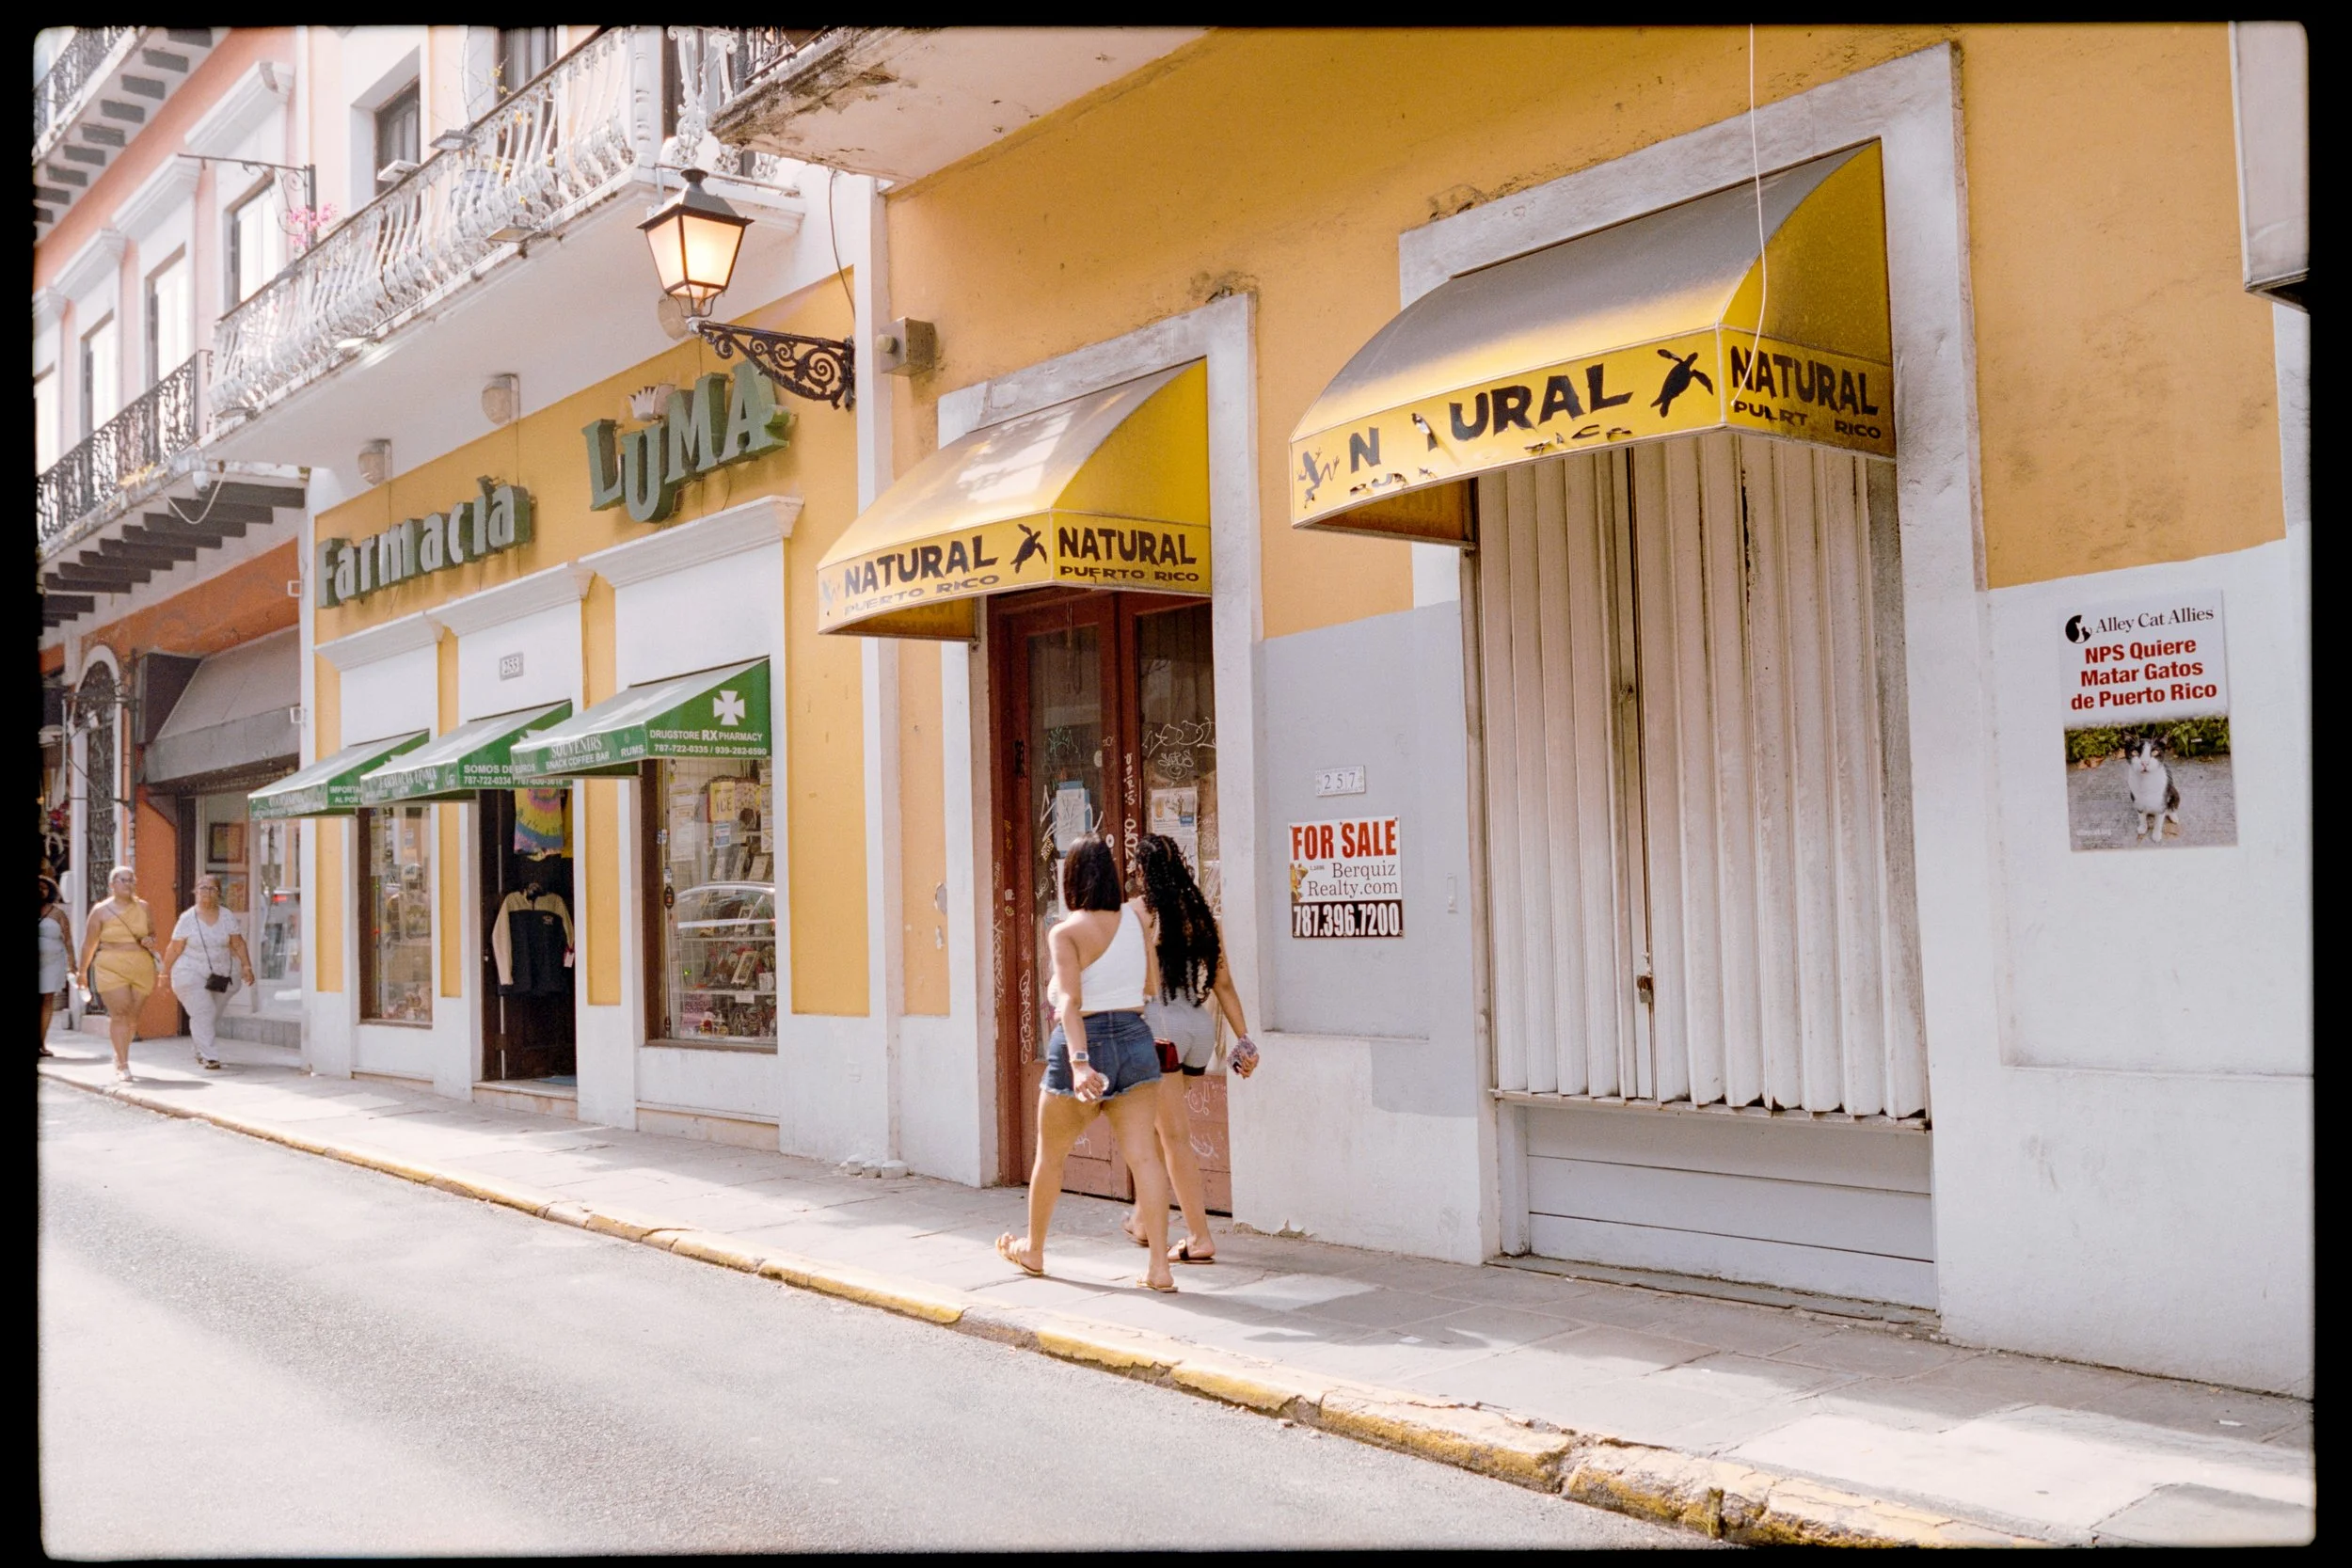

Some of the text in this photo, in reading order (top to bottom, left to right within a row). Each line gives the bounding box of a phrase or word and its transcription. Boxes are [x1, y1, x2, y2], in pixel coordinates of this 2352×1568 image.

[1730, 345, 1880, 417] NATURAL
[582, 360, 790, 524] LUMA
[1835, 420, 1882, 439] RICO
[1058, 526, 1197, 566] NATURAL
[844, 534, 999, 598] NATURAL
[1060, 565, 1200, 582] PUERTO RICO
[844, 574, 1000, 617] PUERTO RICO
[2095, 605, 2215, 635] Alley Cat Allies
[2085, 639, 2197, 664] NPS Quiere
[2080, 661, 2203, 688] Matar Gatos
[2071, 682, 2217, 710] de Puerto Rico
[550, 736, 603, 759] SOUVENIRS
[649, 729, 763, 742] DRUGSTORE RX PHARMACY
[464, 764, 501, 774] SOMOS
[596, 751, 611, 763] BAR
[1323, 771, 1357, 790] 257
[1291, 819, 1398, 862] FOR SALE
[1331, 859, 1397, 880] Berquiz
[1307, 879, 1399, 899] Realty.com
[1294, 902, 1400, 937] 787.396.7200
